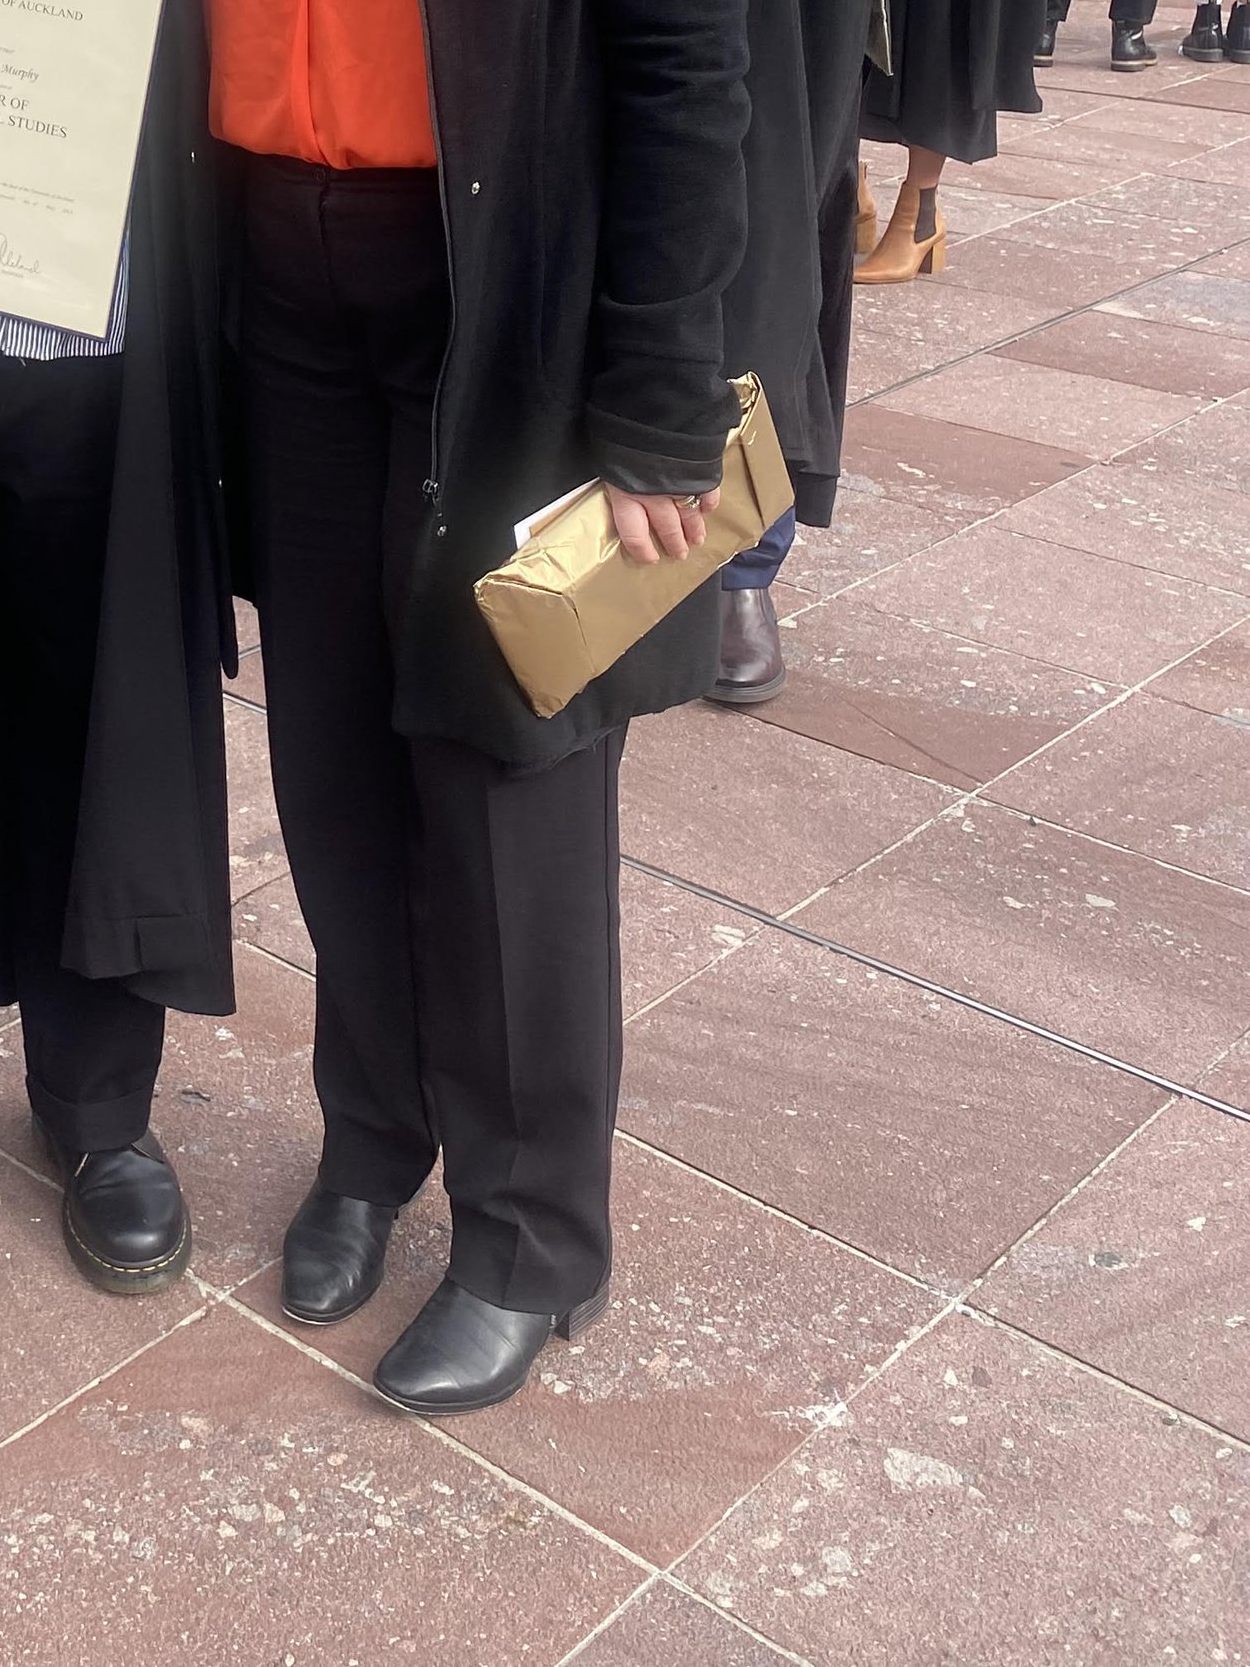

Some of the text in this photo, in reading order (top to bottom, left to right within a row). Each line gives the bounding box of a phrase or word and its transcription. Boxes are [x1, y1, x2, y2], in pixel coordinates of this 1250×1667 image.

[18, 0, 84, 22] AUCKLAND
[1, 63, 39, 82] Murphy
[10, 97, 30, 111] OF
[7, 114, 68, 139] STUDIES
